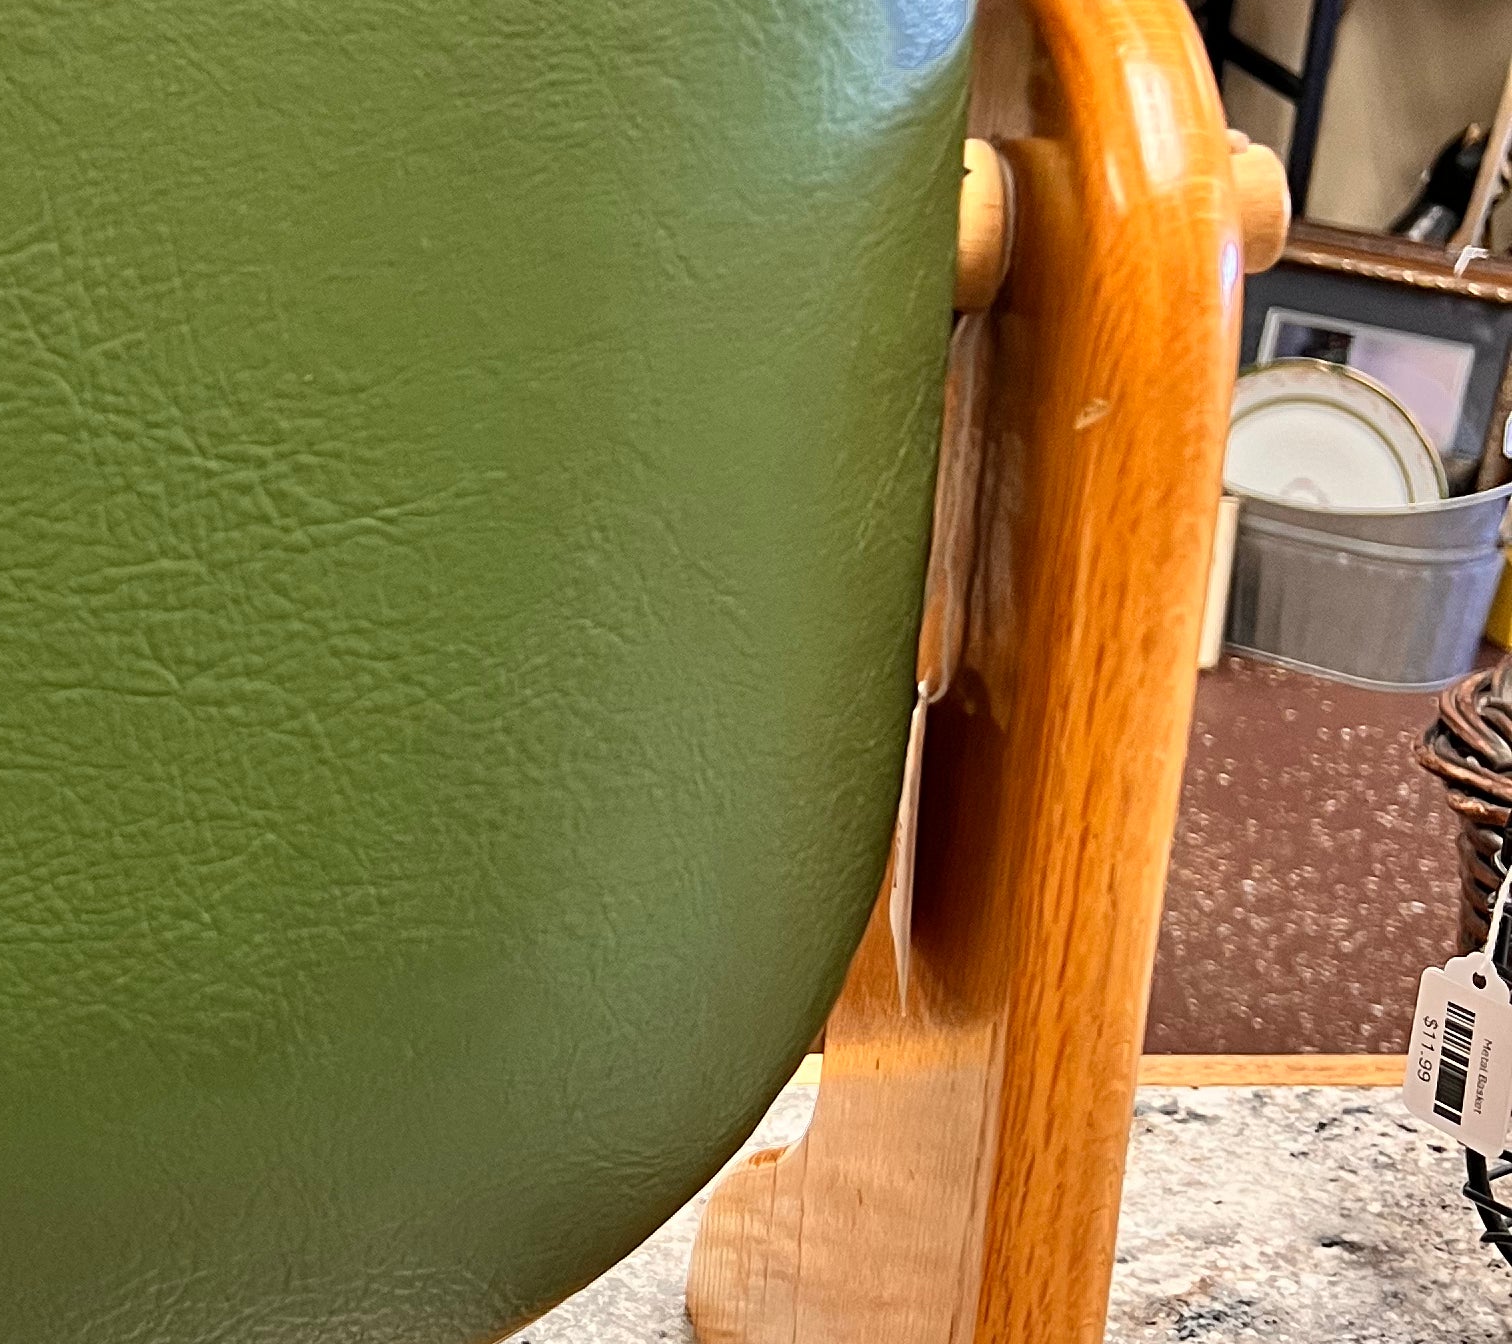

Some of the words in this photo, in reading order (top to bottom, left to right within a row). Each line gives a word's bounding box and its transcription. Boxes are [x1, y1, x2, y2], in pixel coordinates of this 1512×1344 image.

[1418, 1016, 1438, 1082] $11.99
[1480, 1039, 1492, 1072] Metal
[1474, 1074, 1487, 1114] Basket
